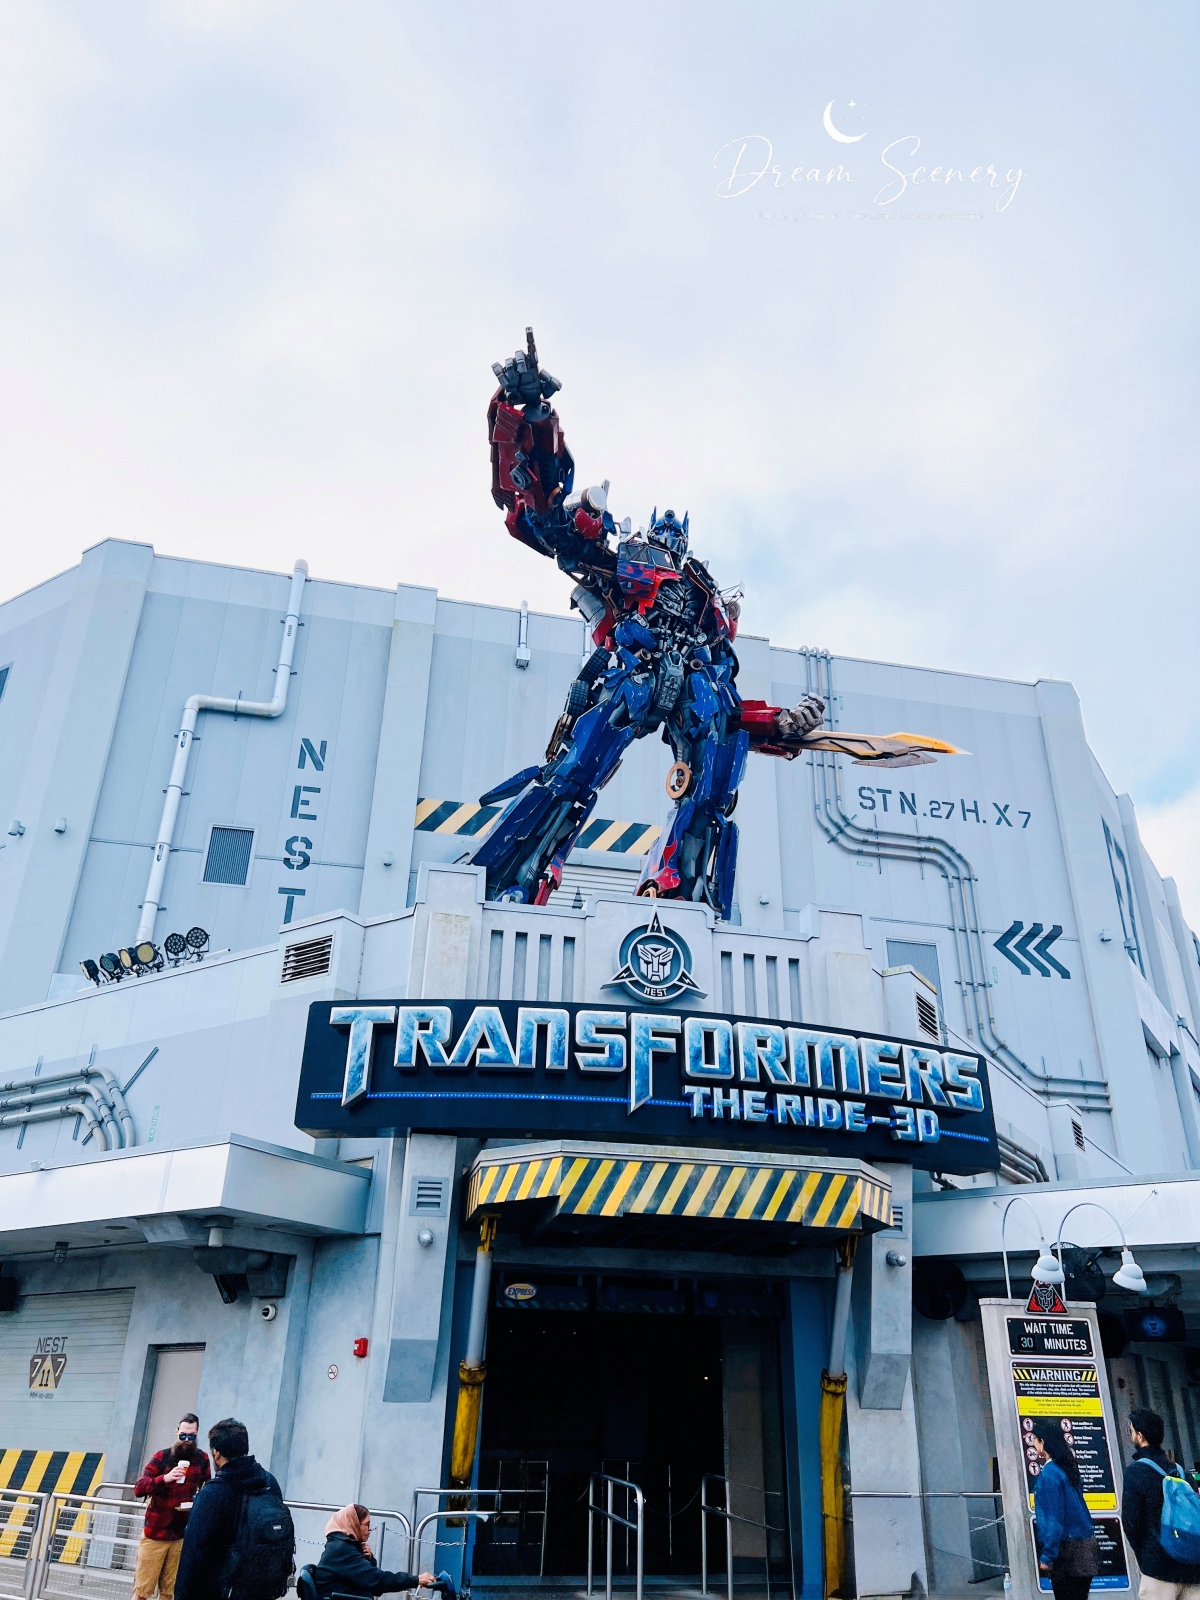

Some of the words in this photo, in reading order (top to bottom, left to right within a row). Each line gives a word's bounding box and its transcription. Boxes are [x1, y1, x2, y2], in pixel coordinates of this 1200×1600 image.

[278, 738, 327, 924] NEST
[643, 986, 667, 997] NEST
[329, 1005, 985, 1116] TRANSFORMERS
[682, 1085, 768, 1123] THE
[774, 1093, 940, 1144] RIDE-3D
[507, 1286, 535, 1299] EXPRESS
[1023, 1322, 1047, 1334] WAIT
[1049, 1323, 1074, 1335] TIME
[36, 1336, 68, 1353] NEST
[1020, 1337, 1034, 1348] 30
[1043, 1338, 1087, 1351] MINUTES
[32, 1358, 42, 1377] 7
[55, 1358, 66, 1377] 7
[1029, 1369, 1081, 1381] WARNING
